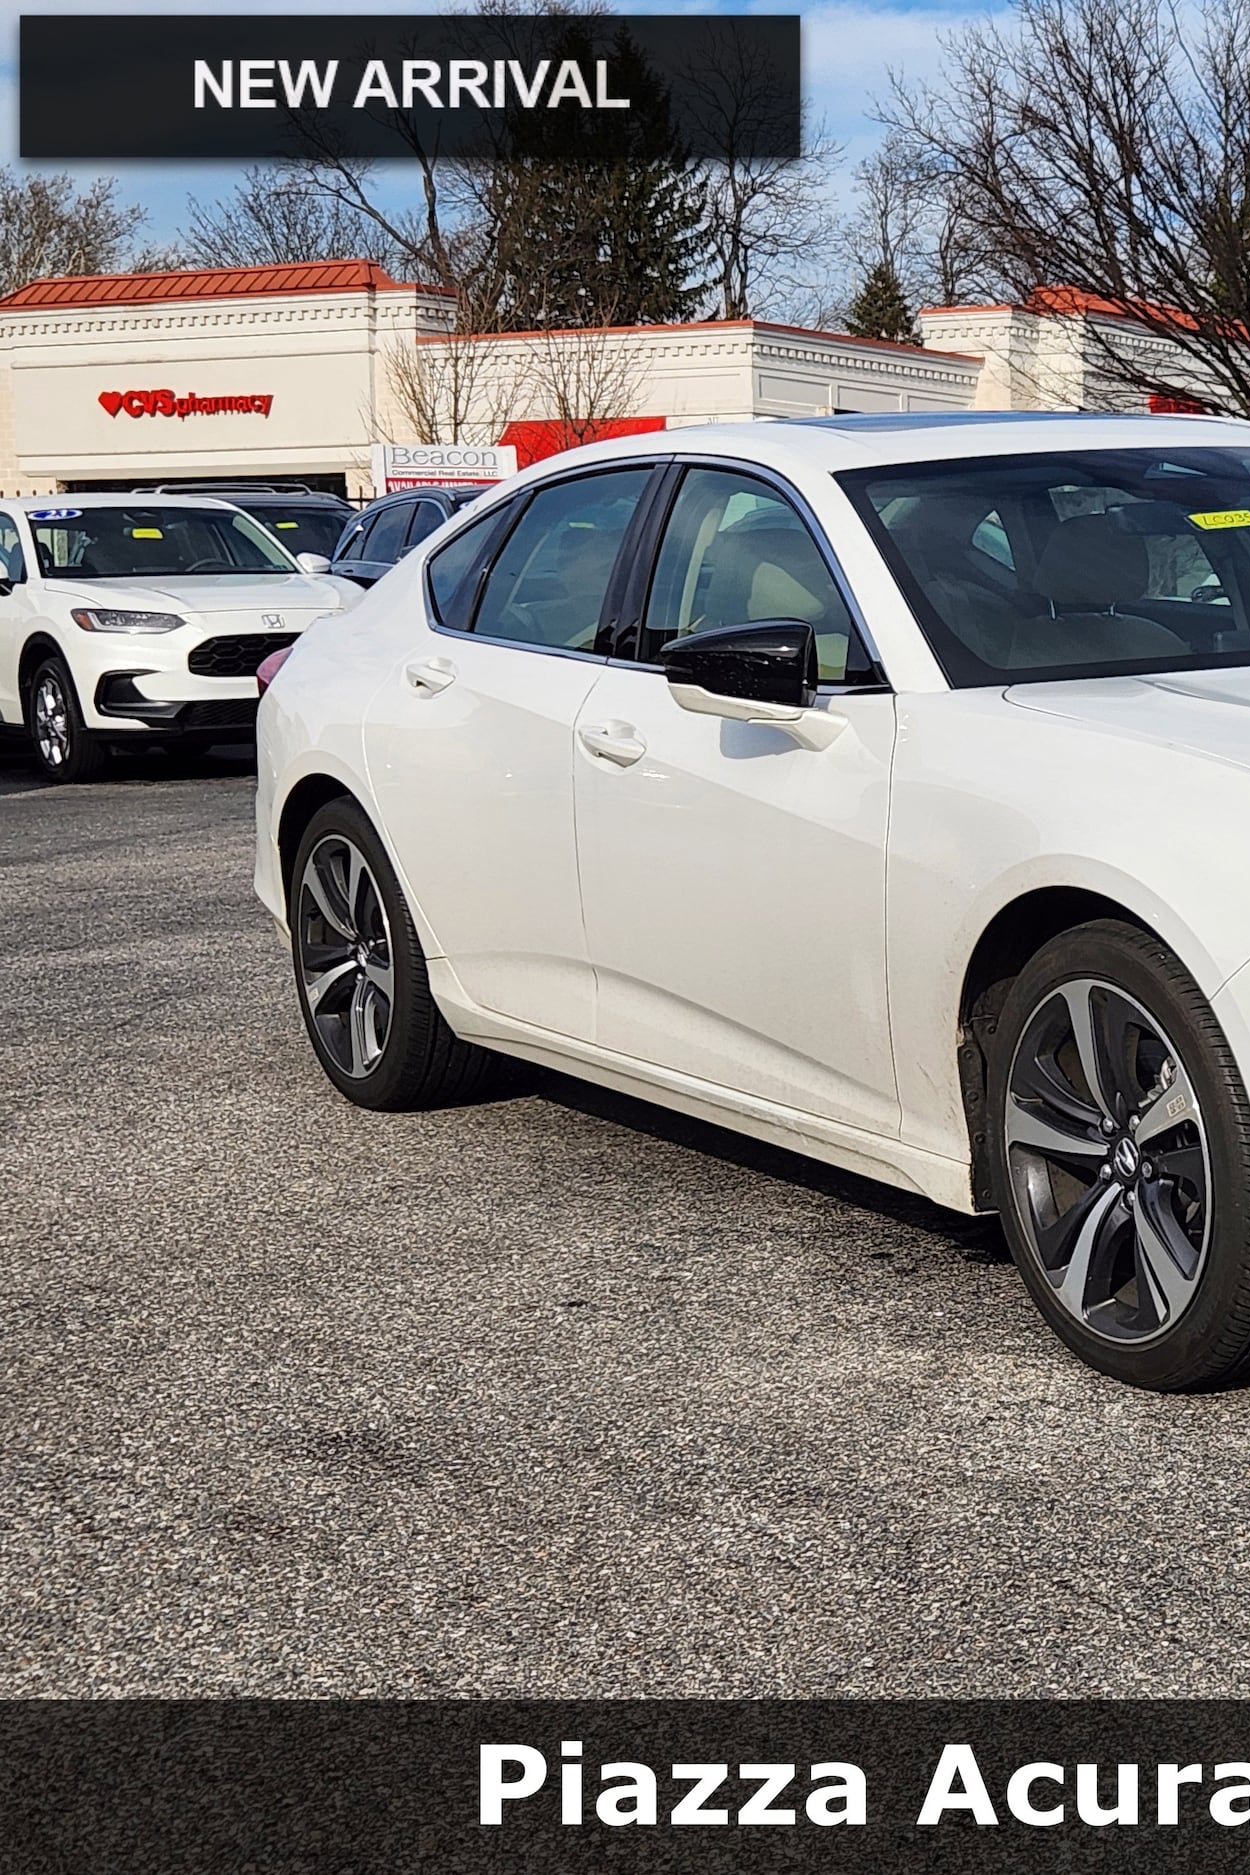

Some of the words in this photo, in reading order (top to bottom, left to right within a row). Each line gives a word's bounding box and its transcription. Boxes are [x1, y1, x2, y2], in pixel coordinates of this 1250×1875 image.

[122, 389, 176, 418] CVS
[175, 392, 273, 421] pharmacy
[391, 447, 497, 466] Beacon
